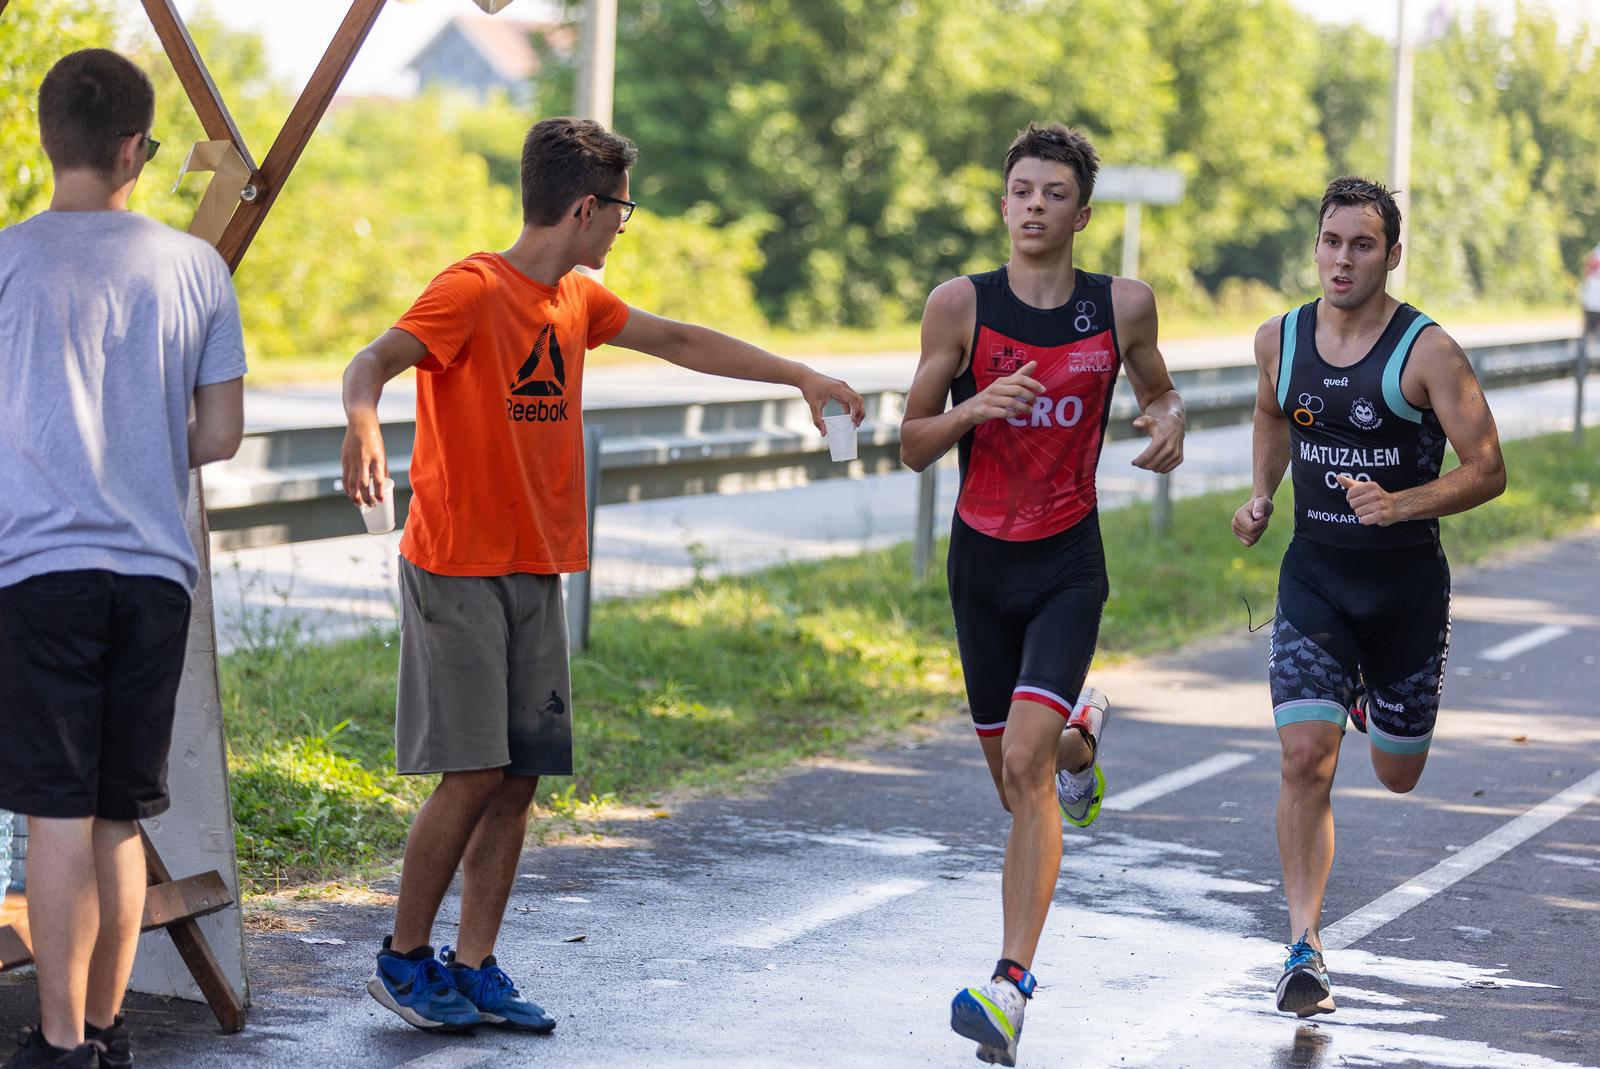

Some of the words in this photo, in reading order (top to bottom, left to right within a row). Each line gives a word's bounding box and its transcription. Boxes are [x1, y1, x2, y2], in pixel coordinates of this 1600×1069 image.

[1323, 377, 1349, 388] quest
[506, 398, 569, 422] Reebok
[1300, 441, 1400, 467] MATUZALEM
[1376, 698, 1405, 713] quest
